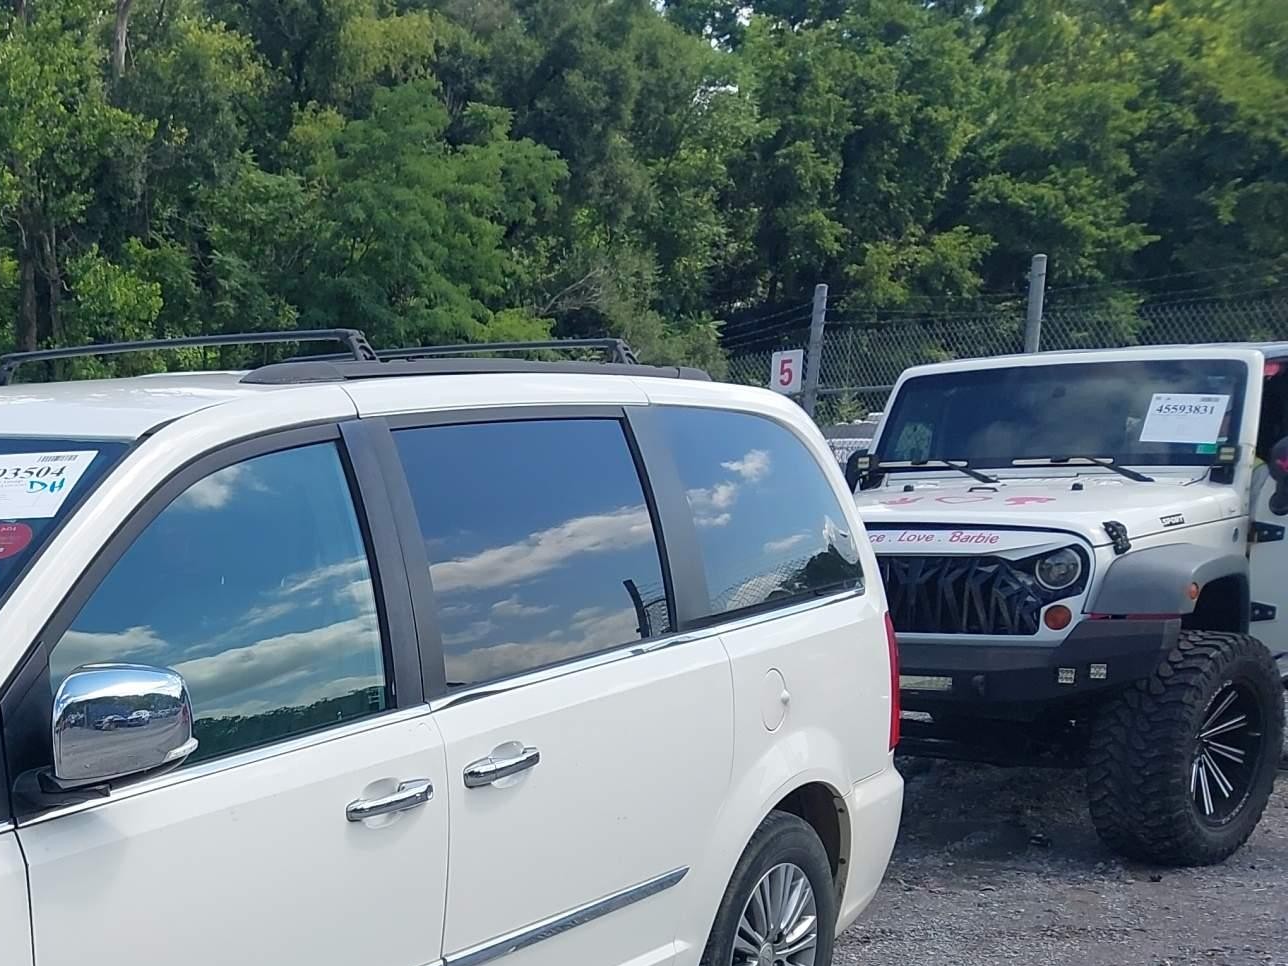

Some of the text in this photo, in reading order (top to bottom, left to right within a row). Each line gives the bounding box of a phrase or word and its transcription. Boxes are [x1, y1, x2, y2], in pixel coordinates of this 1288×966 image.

[780, 359, 792, 386] 5
[1155, 404, 1215, 415] 45593831
[26, 478, 65, 493] DH
[897, 531, 934, 543] Love
[949, 531, 1000, 544] Barbie
